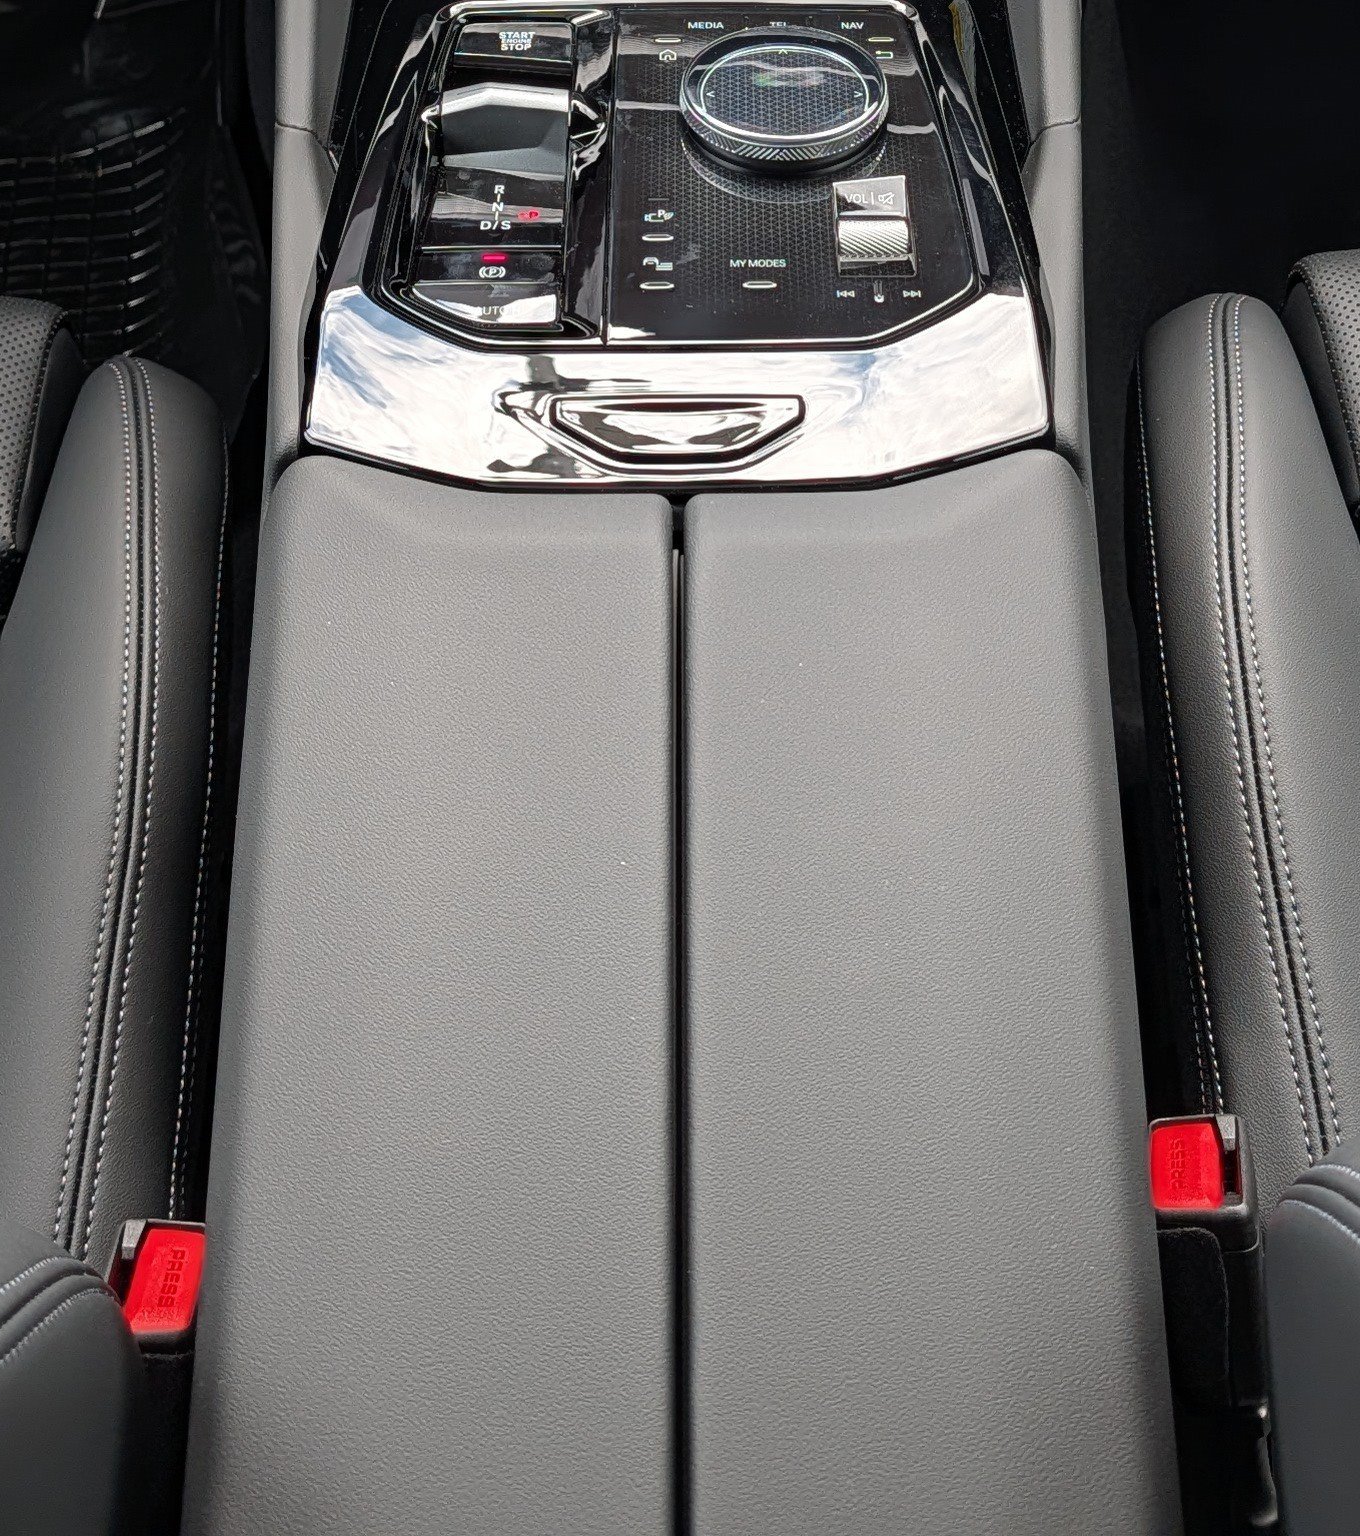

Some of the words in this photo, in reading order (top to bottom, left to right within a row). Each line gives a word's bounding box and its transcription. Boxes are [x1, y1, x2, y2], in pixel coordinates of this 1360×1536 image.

[687, 21, 724, 30] MEDIA
[840, 21, 864, 30] NAV
[498, 31, 536, 39] START
[500, 43, 532, 51] STOP
[493, 184, 505, 194] R
[844, 193, 869, 204] VOL
[491, 202, 504, 212] N
[729, 259, 747, 268] MY
[748, 259, 787, 268] MODES
[157, 1249, 186, 1308] PRESS
